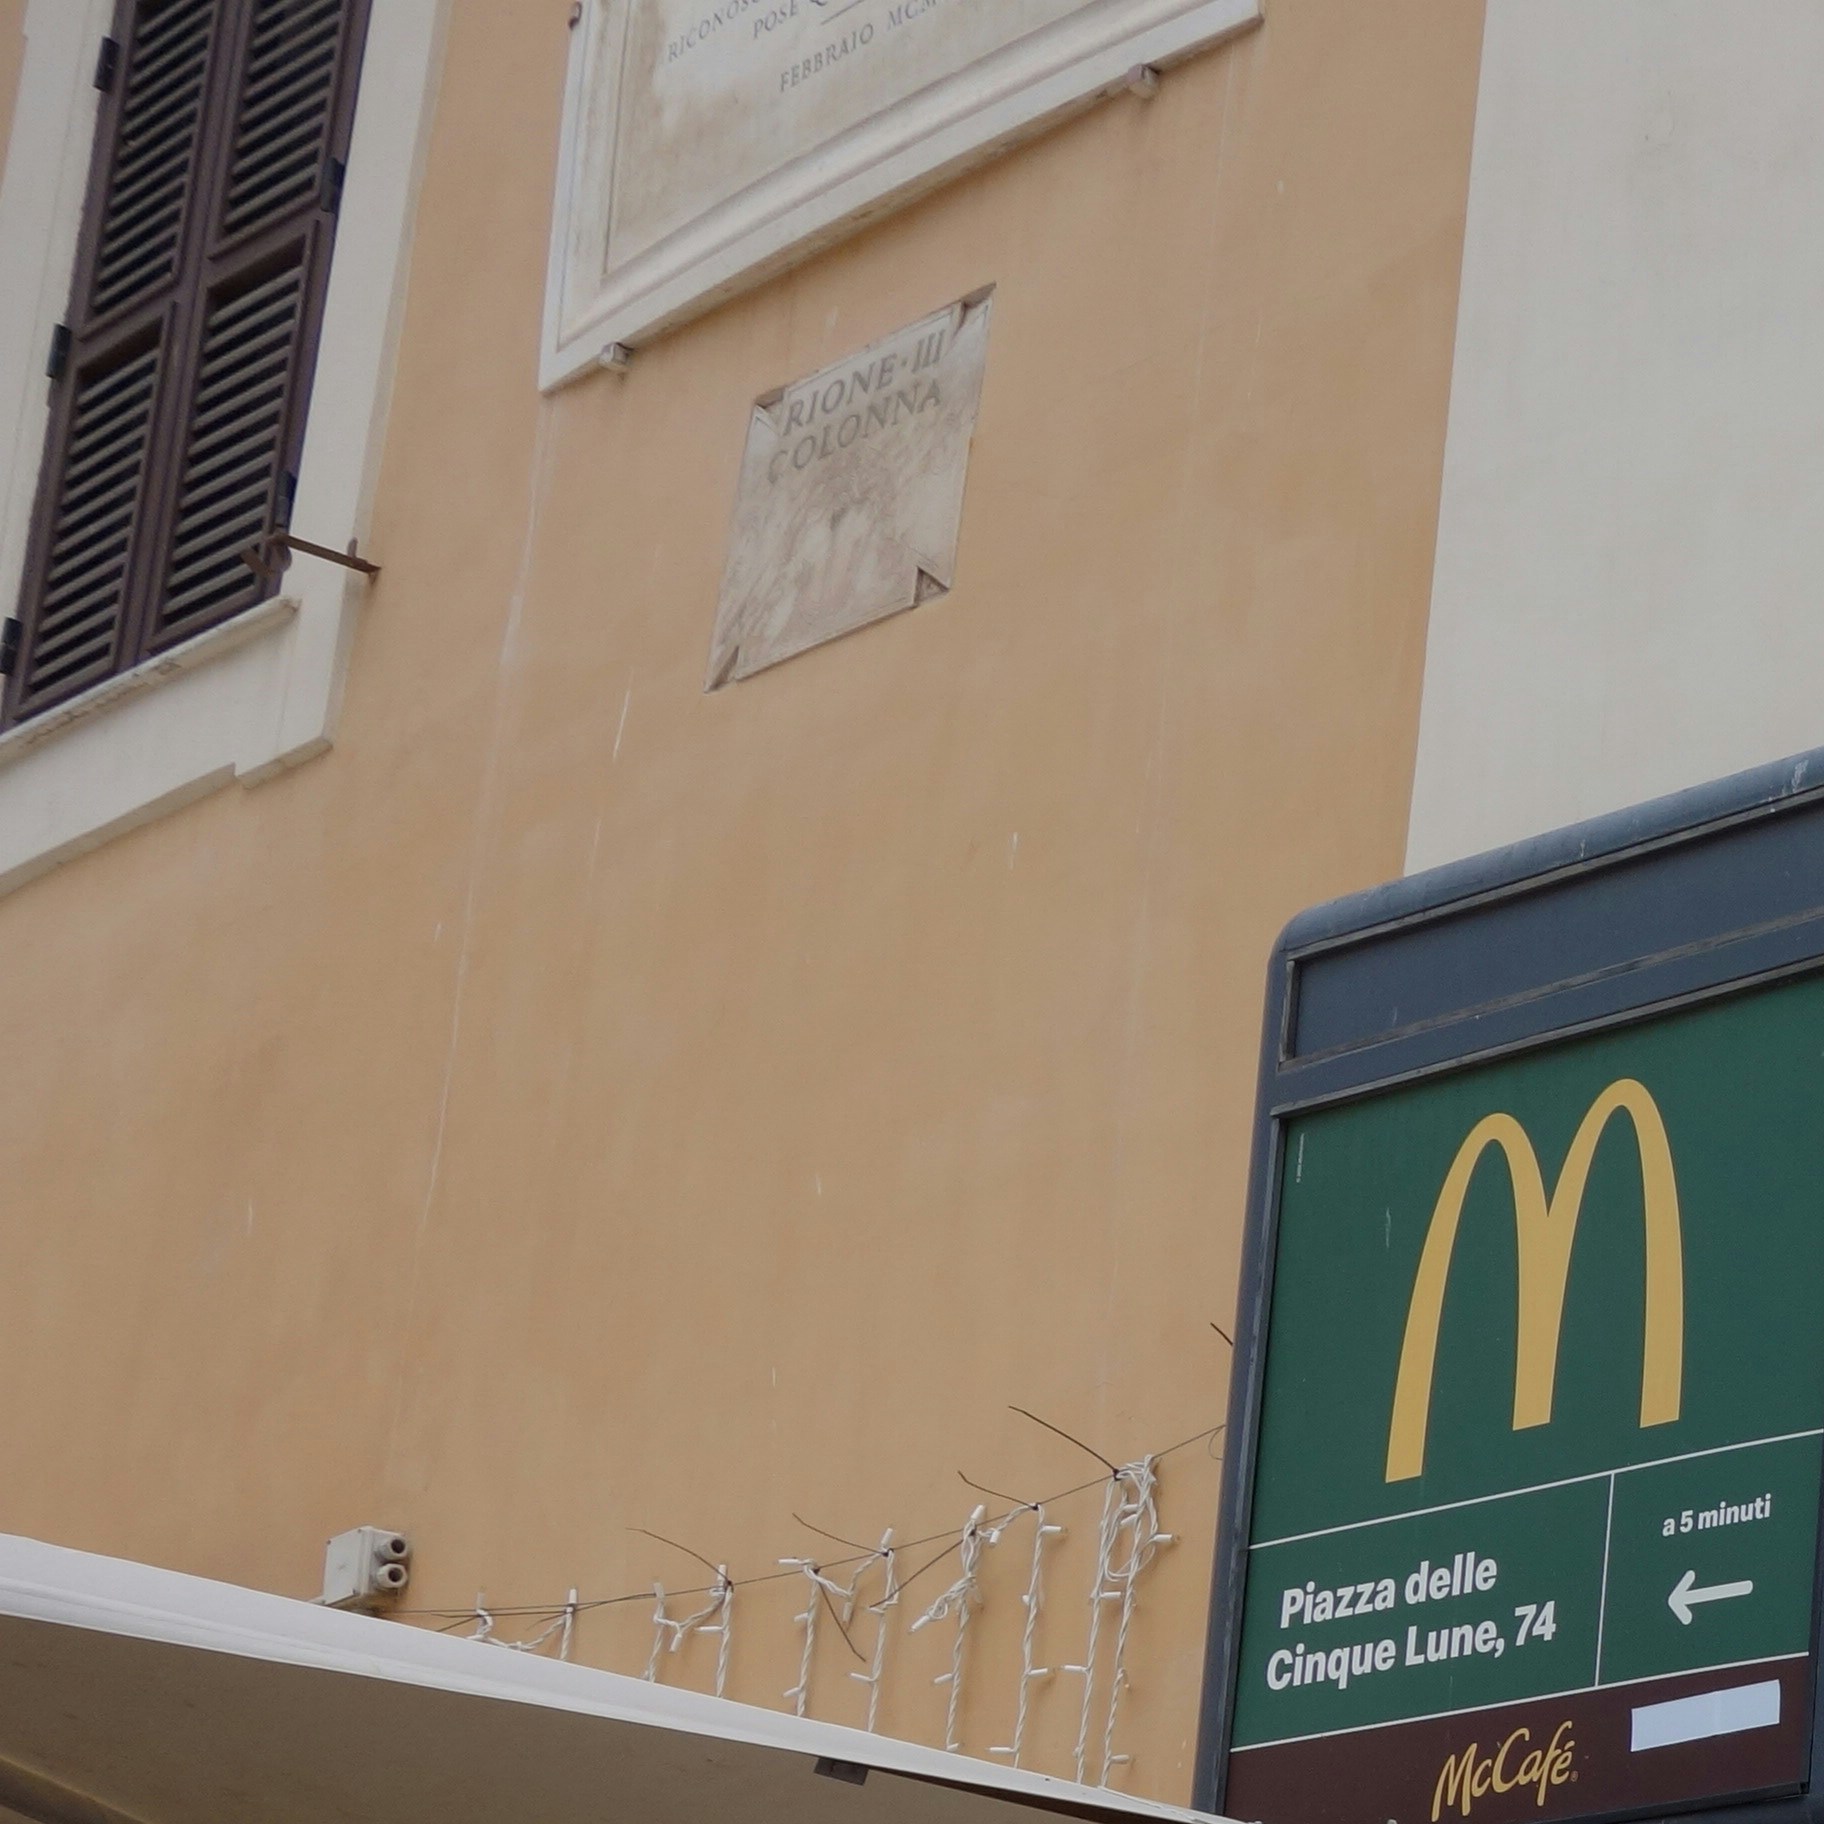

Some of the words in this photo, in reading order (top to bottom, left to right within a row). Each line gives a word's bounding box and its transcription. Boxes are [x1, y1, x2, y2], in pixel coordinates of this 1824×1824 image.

[779, 22, 874, 93] FEBBRAIO
[767, 378, 942, 485] COLONNA
[1661, 1515, 1675, 1538] a
[1679, 1509, 1695, 1534] 5
[1698, 1493, 1773, 1530] minuti
[1280, 1580, 1396, 1629] Piazza
[1404, 1550, 1499, 1603] delle
[1265, 1635, 1397, 1692] Cinque
[1404, 1617, 1505, 1667] Lune,
[1513, 1599, 1558, 1648] 74
[1429, 1719, 1576, 1822] McCafé
